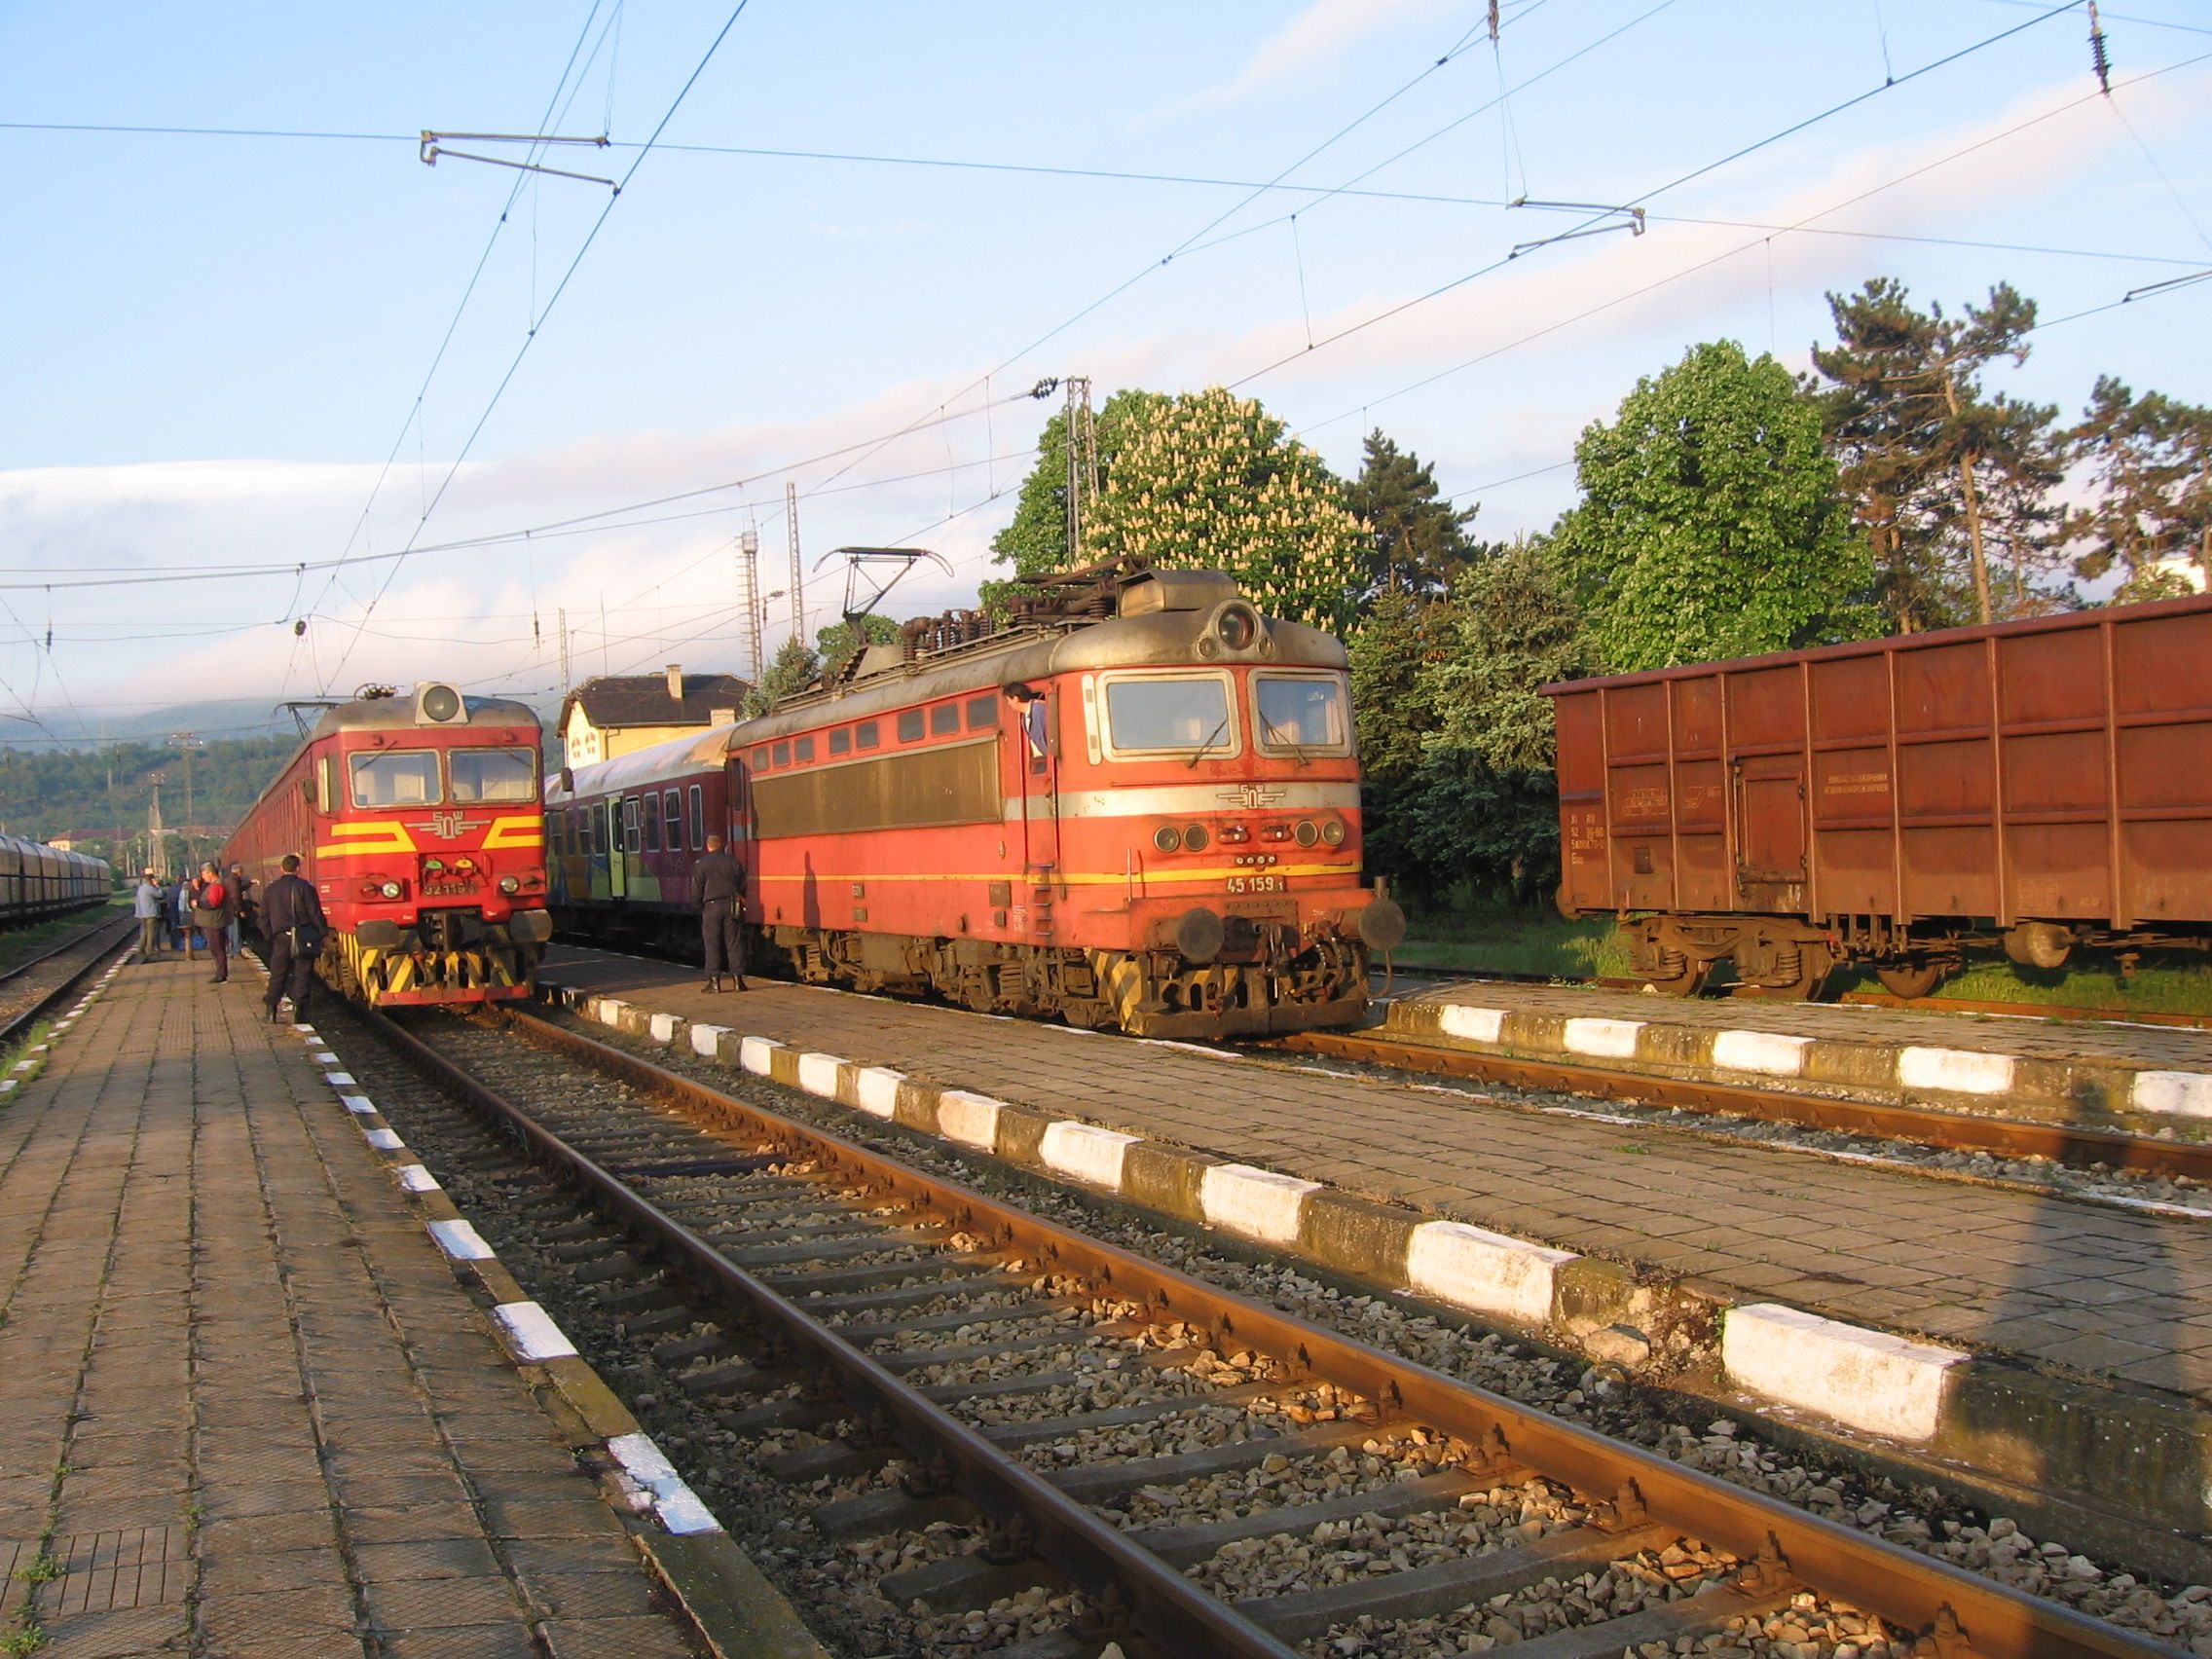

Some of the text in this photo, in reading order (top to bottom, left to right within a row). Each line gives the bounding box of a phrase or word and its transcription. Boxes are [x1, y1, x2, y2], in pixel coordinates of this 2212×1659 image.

[1227, 876, 1284, 893] 45 159 1
